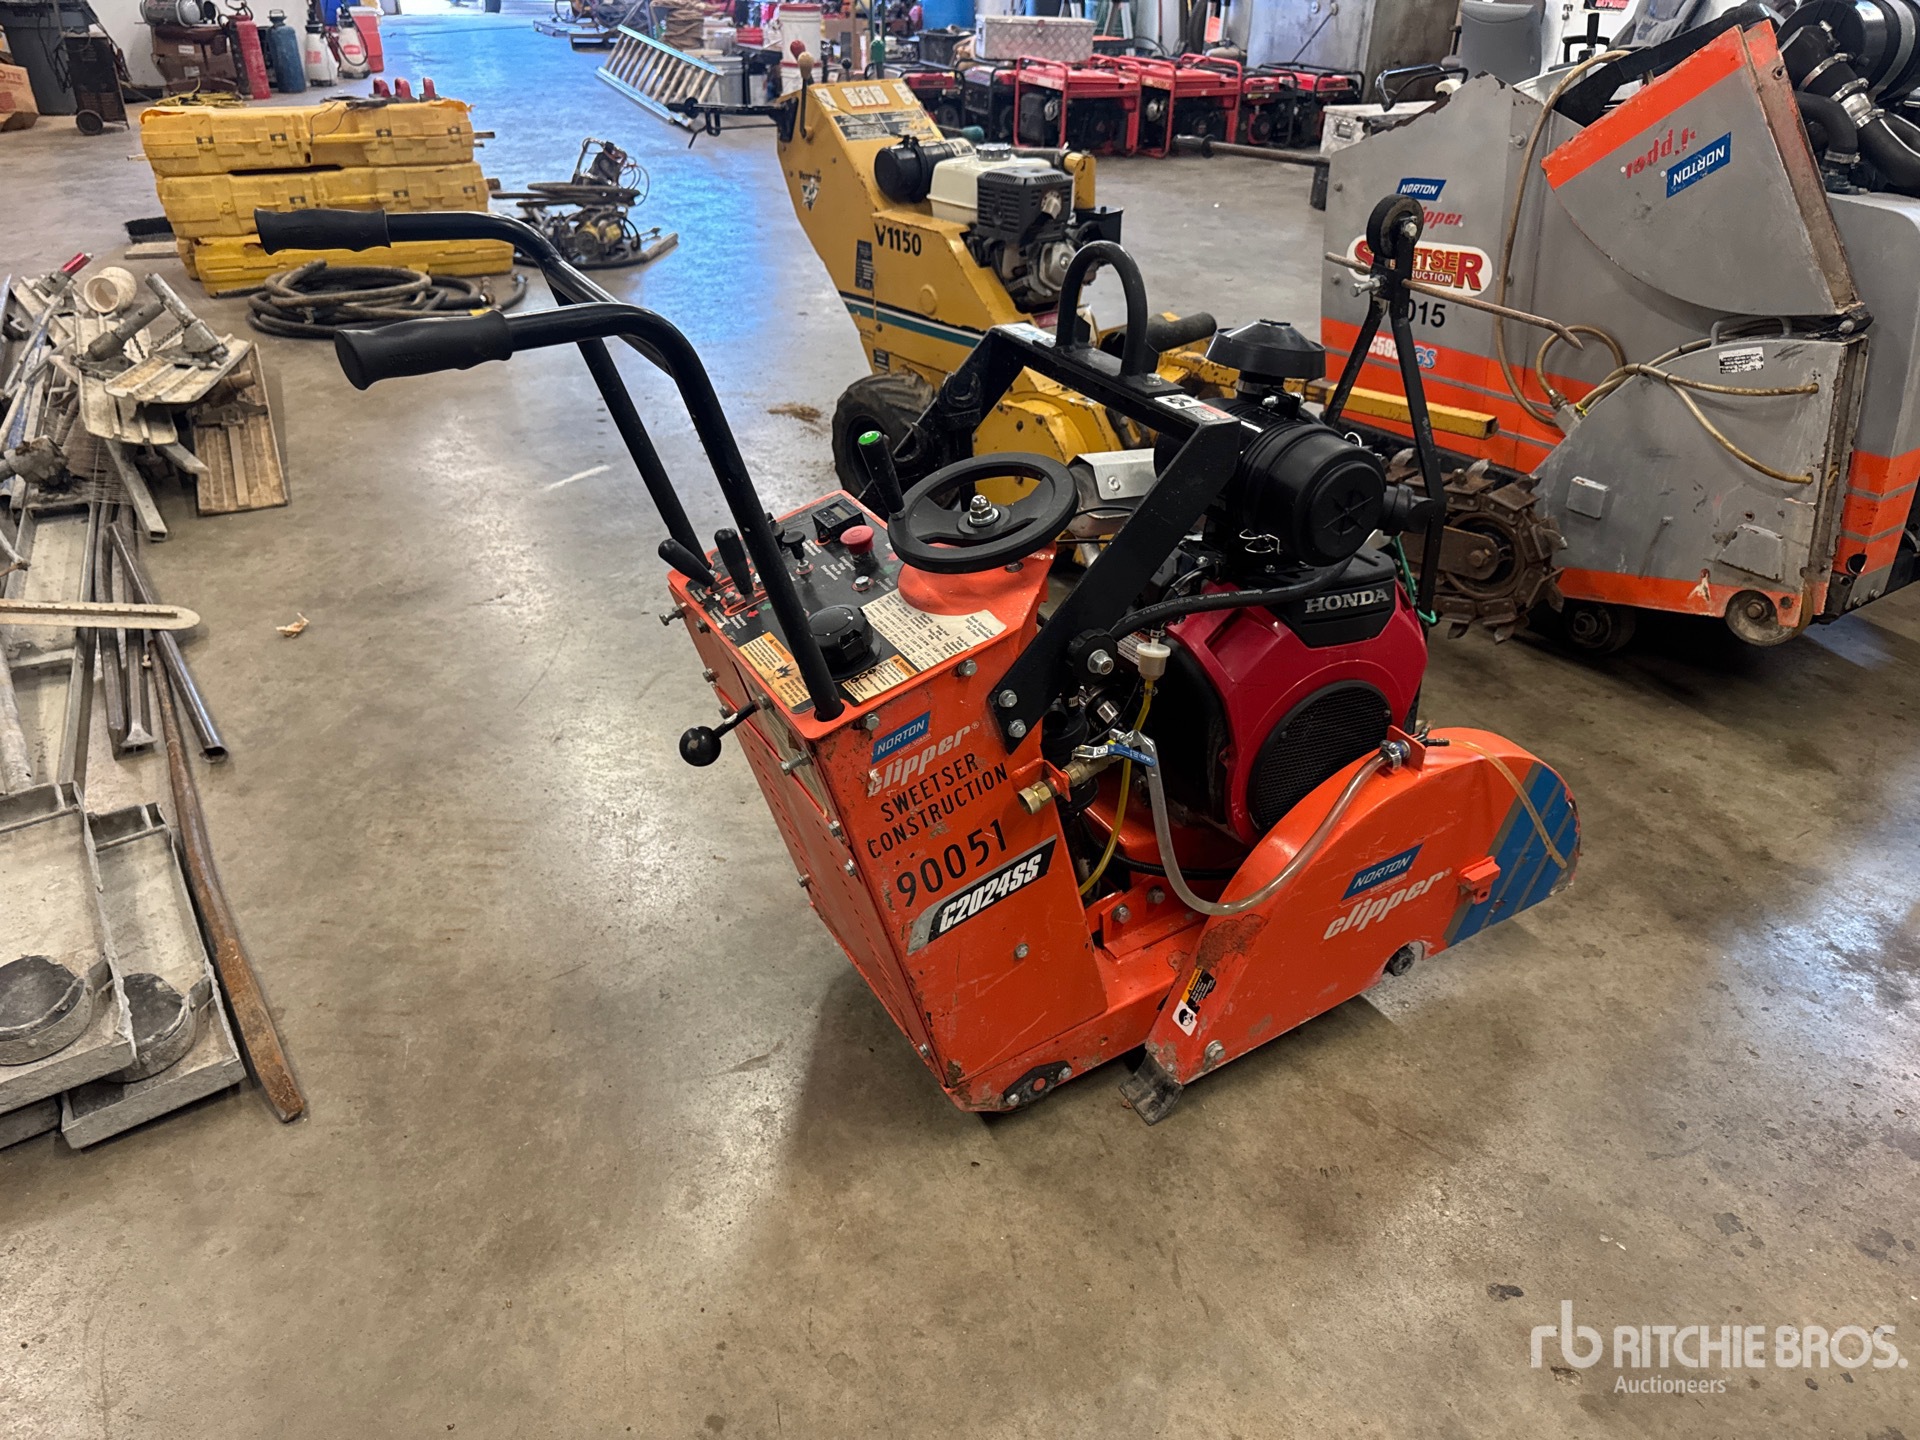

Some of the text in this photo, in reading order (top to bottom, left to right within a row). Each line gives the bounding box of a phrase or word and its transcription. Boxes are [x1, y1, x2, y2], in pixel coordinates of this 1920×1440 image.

[1400, 183, 1439, 195] NORTON
[1672, 144, 1725, 186] NORTON
[874, 223, 921, 256] V1150
[1305, 589, 1390, 613] HONDA
[868, 726, 970, 797] clipper
[877, 720, 925, 755] NORTON
[867, 763, 1008, 859] CONSTRUCTION
[881, 753, 978, 822] SWEETSER
[897, 819, 1007, 907] 90051
[1353, 855, 1411, 889] NORTON
[940, 854, 1042, 933] C2024SS
[1323, 872, 1444, 940] clipper
